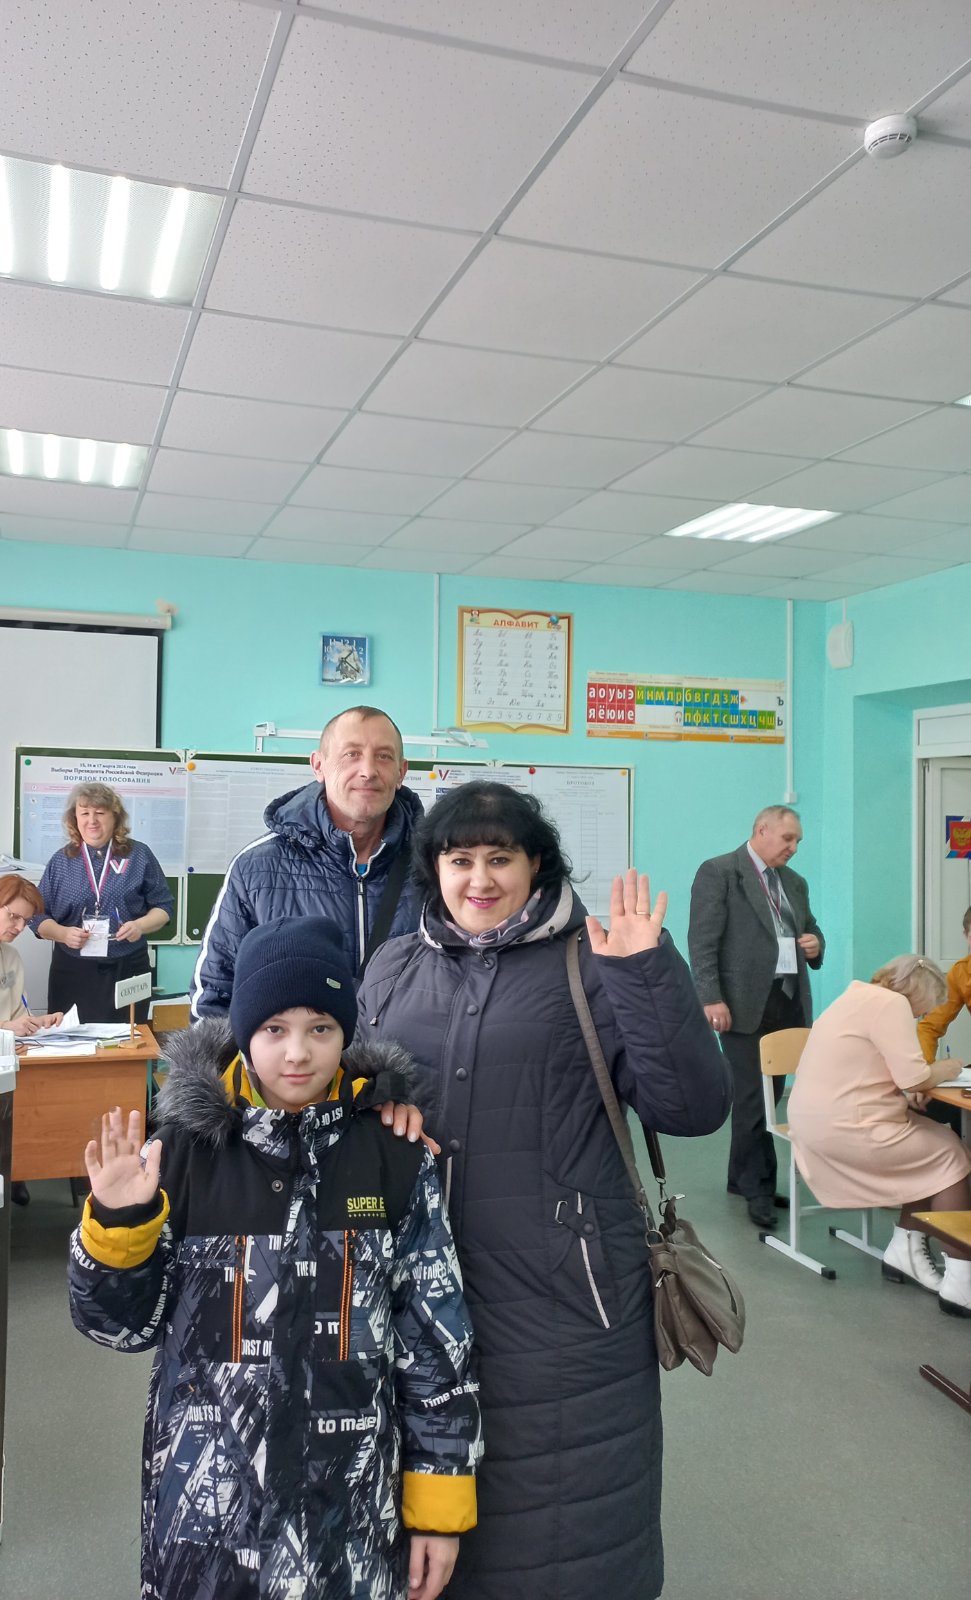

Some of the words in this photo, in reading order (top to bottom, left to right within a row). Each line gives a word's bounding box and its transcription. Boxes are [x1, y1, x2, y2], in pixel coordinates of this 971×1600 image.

[493, 619, 539, 628] АЛФАВИТ
[347, 1197, 377, 1210] SUPER
[380, 1197, 384, 1209] E
[421, 1392, 450, 1408] Time
[318, 1417, 336, 1434] to
